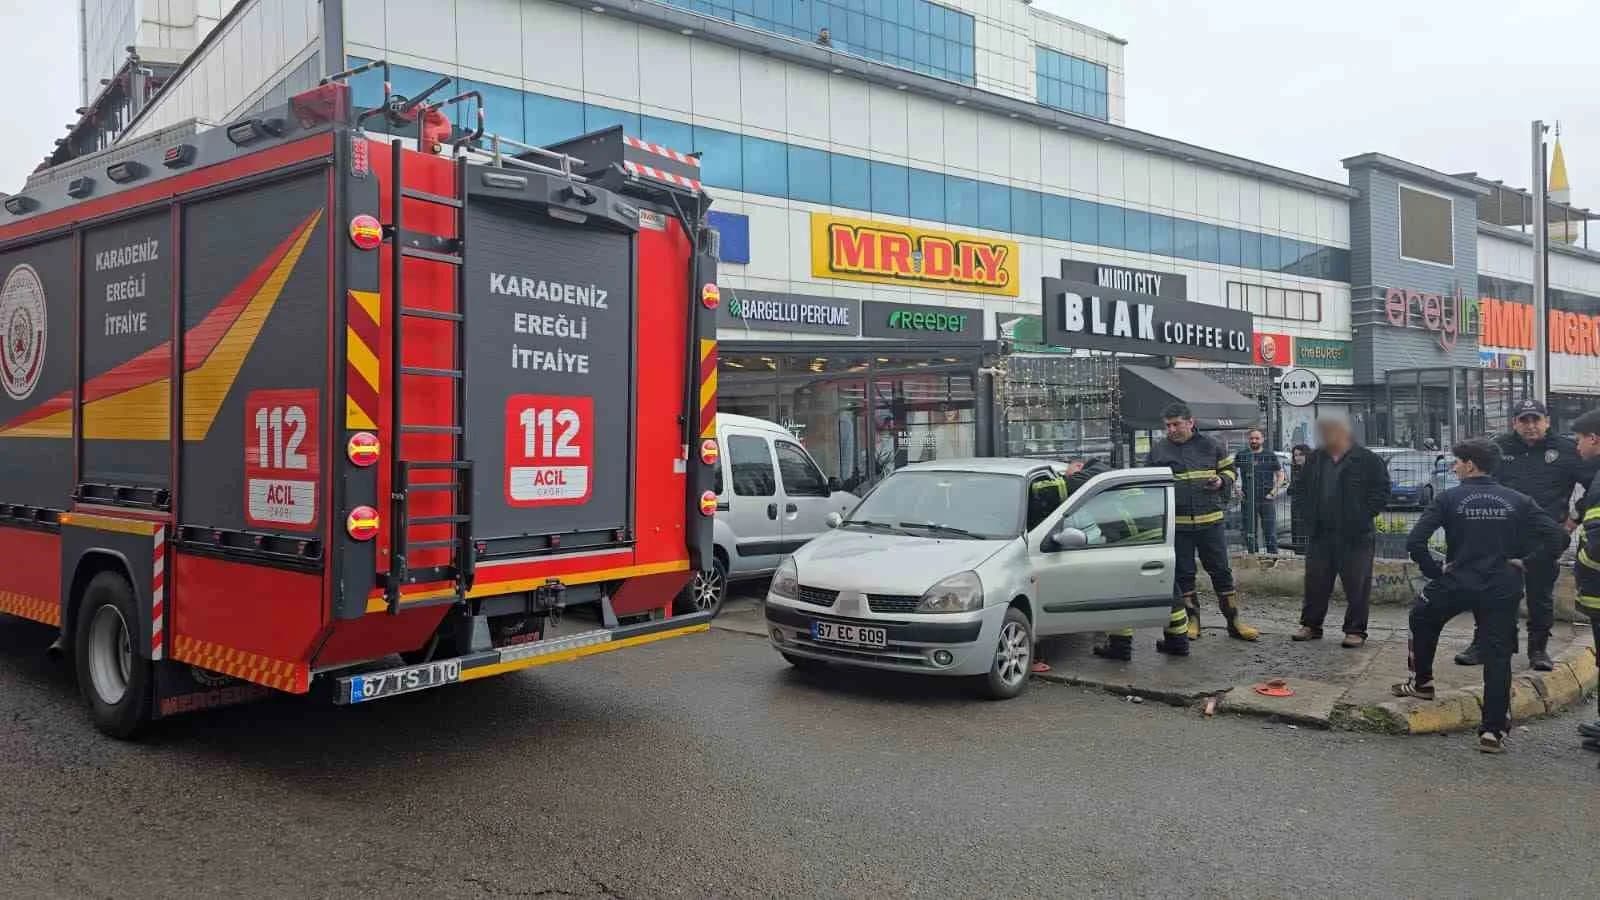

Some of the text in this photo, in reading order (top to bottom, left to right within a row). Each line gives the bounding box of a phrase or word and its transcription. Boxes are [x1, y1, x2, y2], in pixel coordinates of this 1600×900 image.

[95, 237, 159, 271] KARADENİZ
[106, 273, 146, 302] EREĞLİ
[489, 272, 608, 309] KARADENİZ
[1134, 271, 1161, 296] CITY
[105, 311, 147, 336] İTFAİYE
[514, 312, 587, 340] EREĞLİ
[741, 299, 849, 325] BARGELLO PERFUME
[1064, 292, 1155, 340] BLAK
[1164, 320, 1222, 348] COFFEE
[1229, 330, 1250, 352] CO.
[511, 343, 589, 373] İTFAİYE
[1283, 380, 1316, 389] BLAK
[255, 405, 308, 469] 112
[519, 408, 580, 457] 112
[818, 623, 884, 643] 67 EC 609
[363, 661, 459, 697] 67 TS 110
